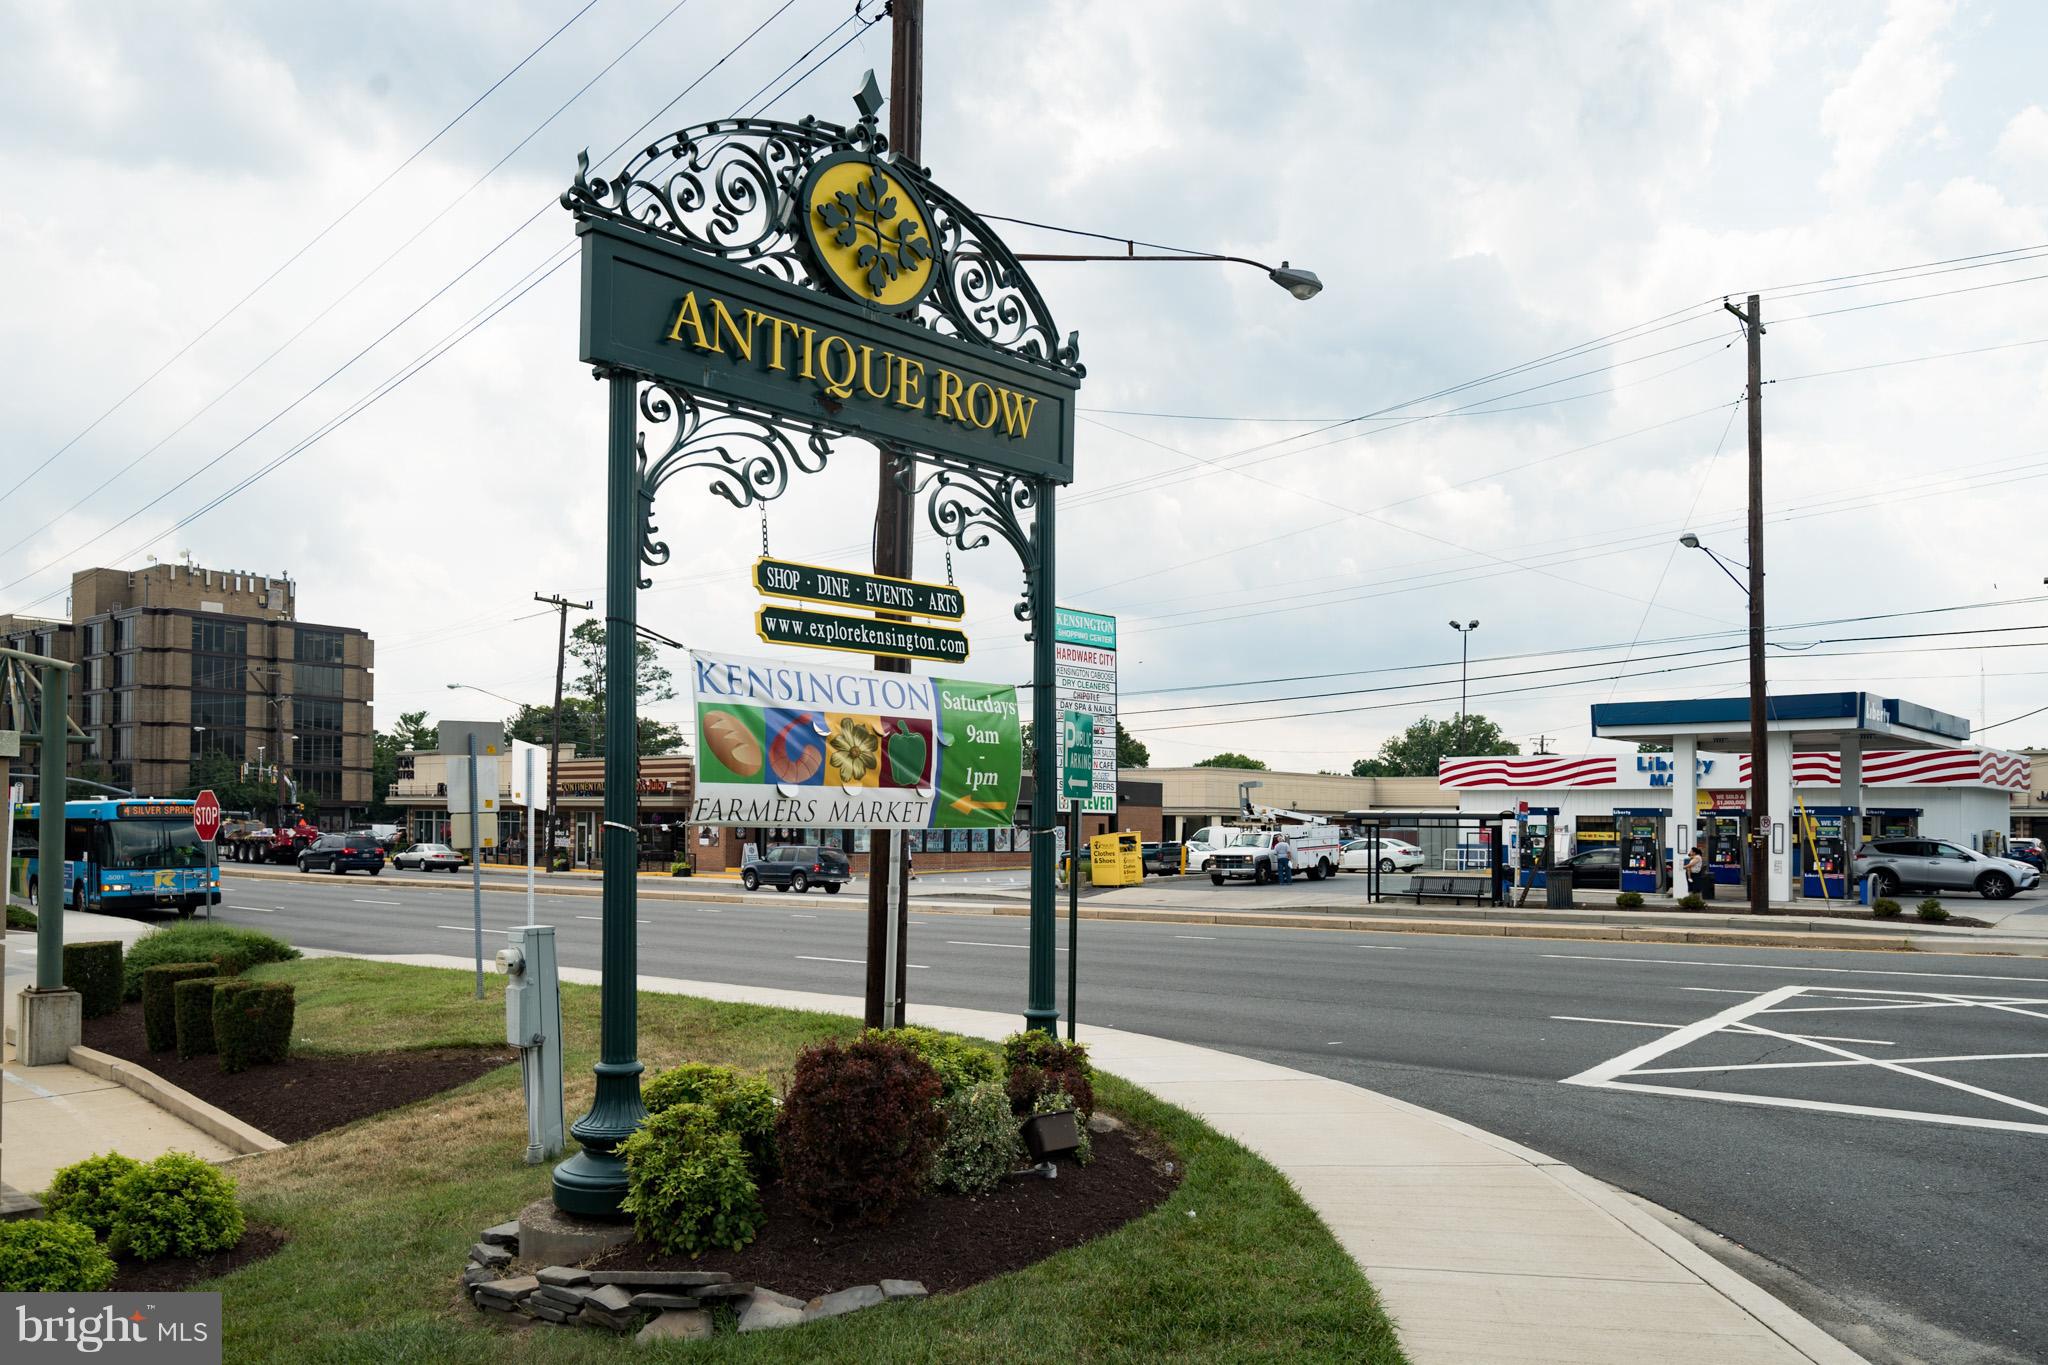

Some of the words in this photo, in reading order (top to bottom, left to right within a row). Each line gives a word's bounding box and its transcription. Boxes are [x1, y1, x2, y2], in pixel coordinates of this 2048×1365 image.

[667, 291, 925, 409] ANTIQUE
[936, 368, 1038, 439] ROW
[766, 566, 800, 591] SHOP
[817, 574, 851, 599] DINE
[865, 581, 914, 607] EVENTS
[929, 592, 958, 614] ARTS
[1056, 612, 1114, 633] KENSINGTON
[765, 616, 967, 654] www.explorekensington.com
[1058, 628, 1088, 640] SHOPPING
[1089, 633, 1112, 644] CENTER
[1056, 647, 1097, 664] HARDWARE
[1099, 652, 1114, 667] CITY
[1056, 666, 1090, 678] KENSINGTON
[1090, 671, 1114, 681] CABOOSE
[695, 659, 930, 713] KENSINGTON
[1062, 678, 1075, 687] DRY
[1077, 681, 1110, 692] CLEANERS
[943, 690, 1016, 718] Saturdays
[1072, 691, 1100, 701] CHIPOTLE
[1060, 701, 1075, 710] DAY
[1075, 702, 1087, 711] SPA
[1093, 704, 1112, 713] NAILS
[1865, 700, 1890, 726] Liberty
[966, 724, 999, 745] 9am
[560, 782, 604, 791] CONTINENTAL
[965, 766, 998, 787] 1pm
[123, 806, 130, 817] 4
[132, 806, 161, 815] SILVER
[164, 805, 194, 815] SPRING
[195, 811, 218, 826] STOP
[695, 797, 818, 824] FARMERS
[828, 801, 928, 824] MARKET
